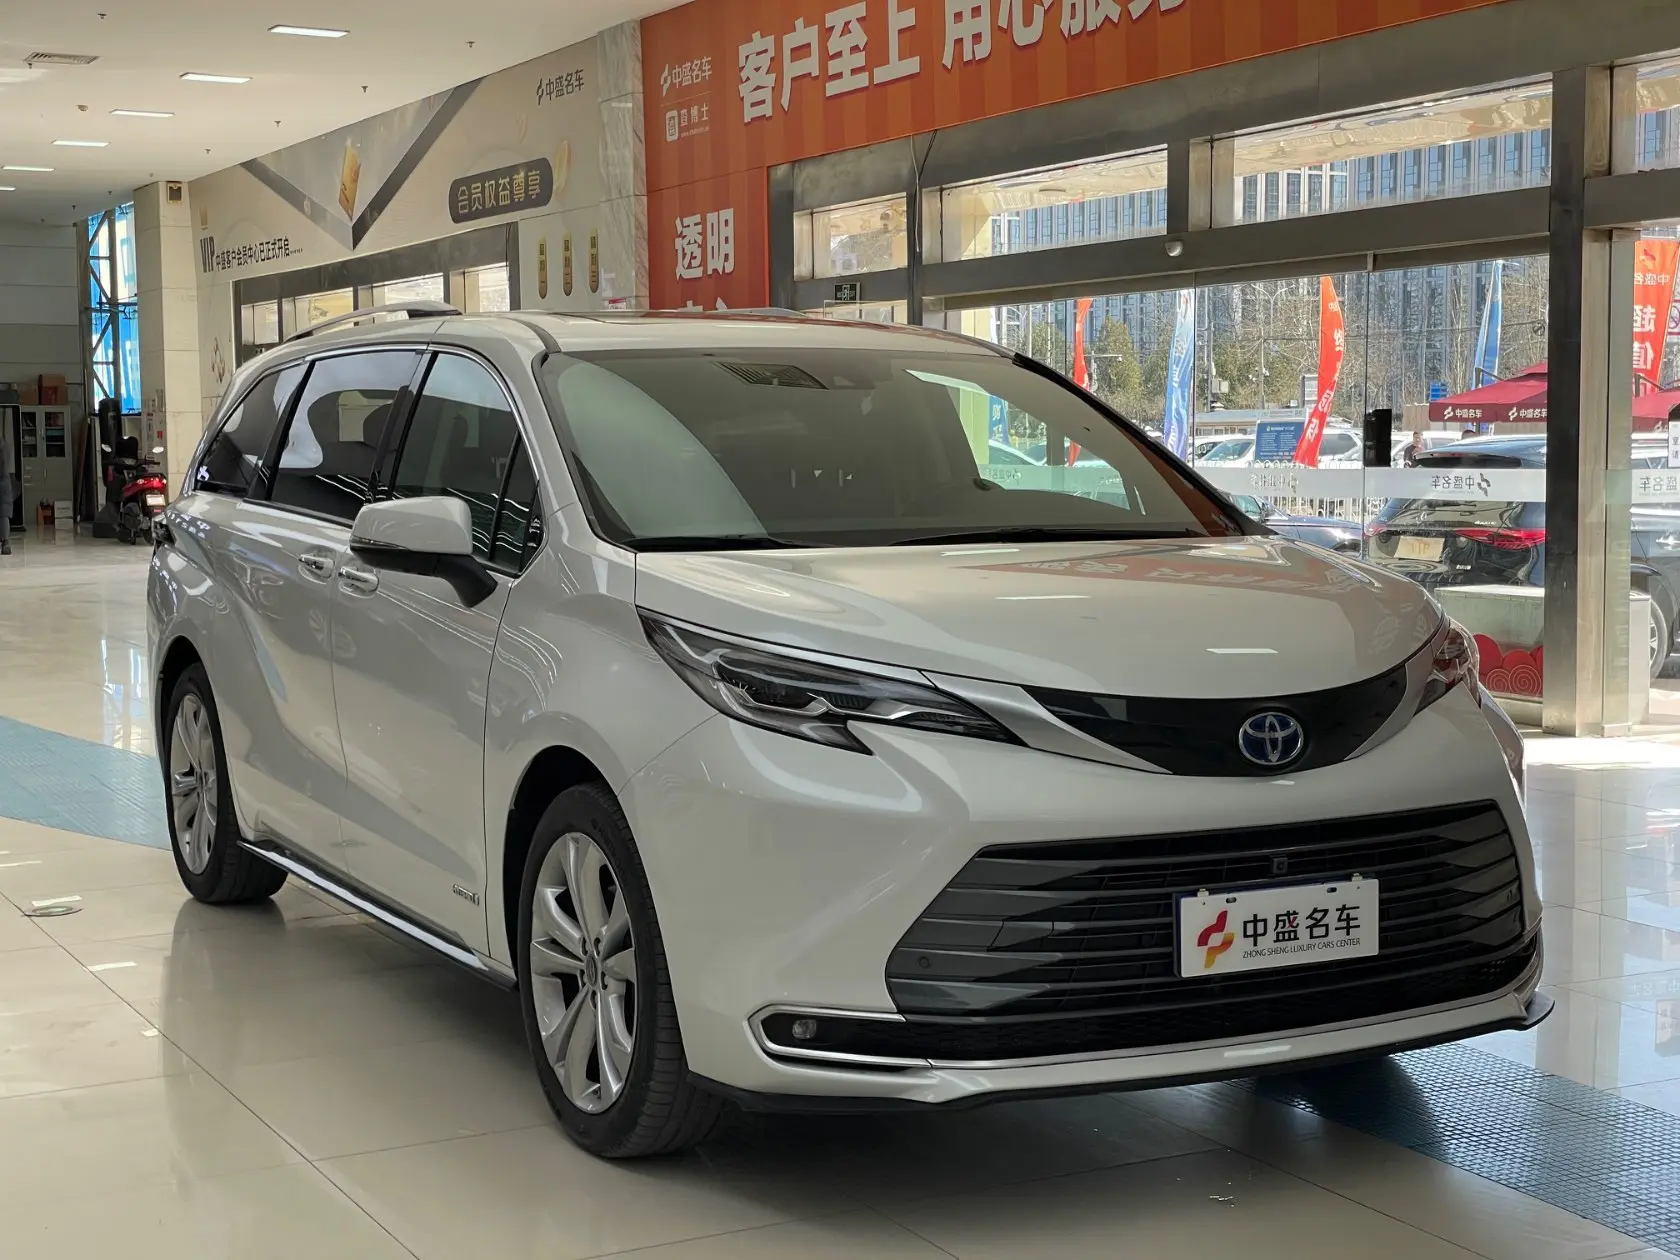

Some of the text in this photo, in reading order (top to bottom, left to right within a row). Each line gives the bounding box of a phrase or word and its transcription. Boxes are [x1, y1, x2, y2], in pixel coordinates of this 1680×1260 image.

[672, 56, 712, 88] 中盛名车
[738, 0, 1186, 124] 客户至上 用心
[545, 69, 585, 100] 中盛名车
[457, 170, 541, 214] 会员权益尊享
[200, 236, 215, 273] VIP
[675, 208, 735, 280] 透明
[1456, 409, 1482, 418] 中盛名车
[1242, 904, 1361, 947] 中盛名车
[1242, 937, 1361, 959] ZHONG SHENG LUXURY CARS CENTER
